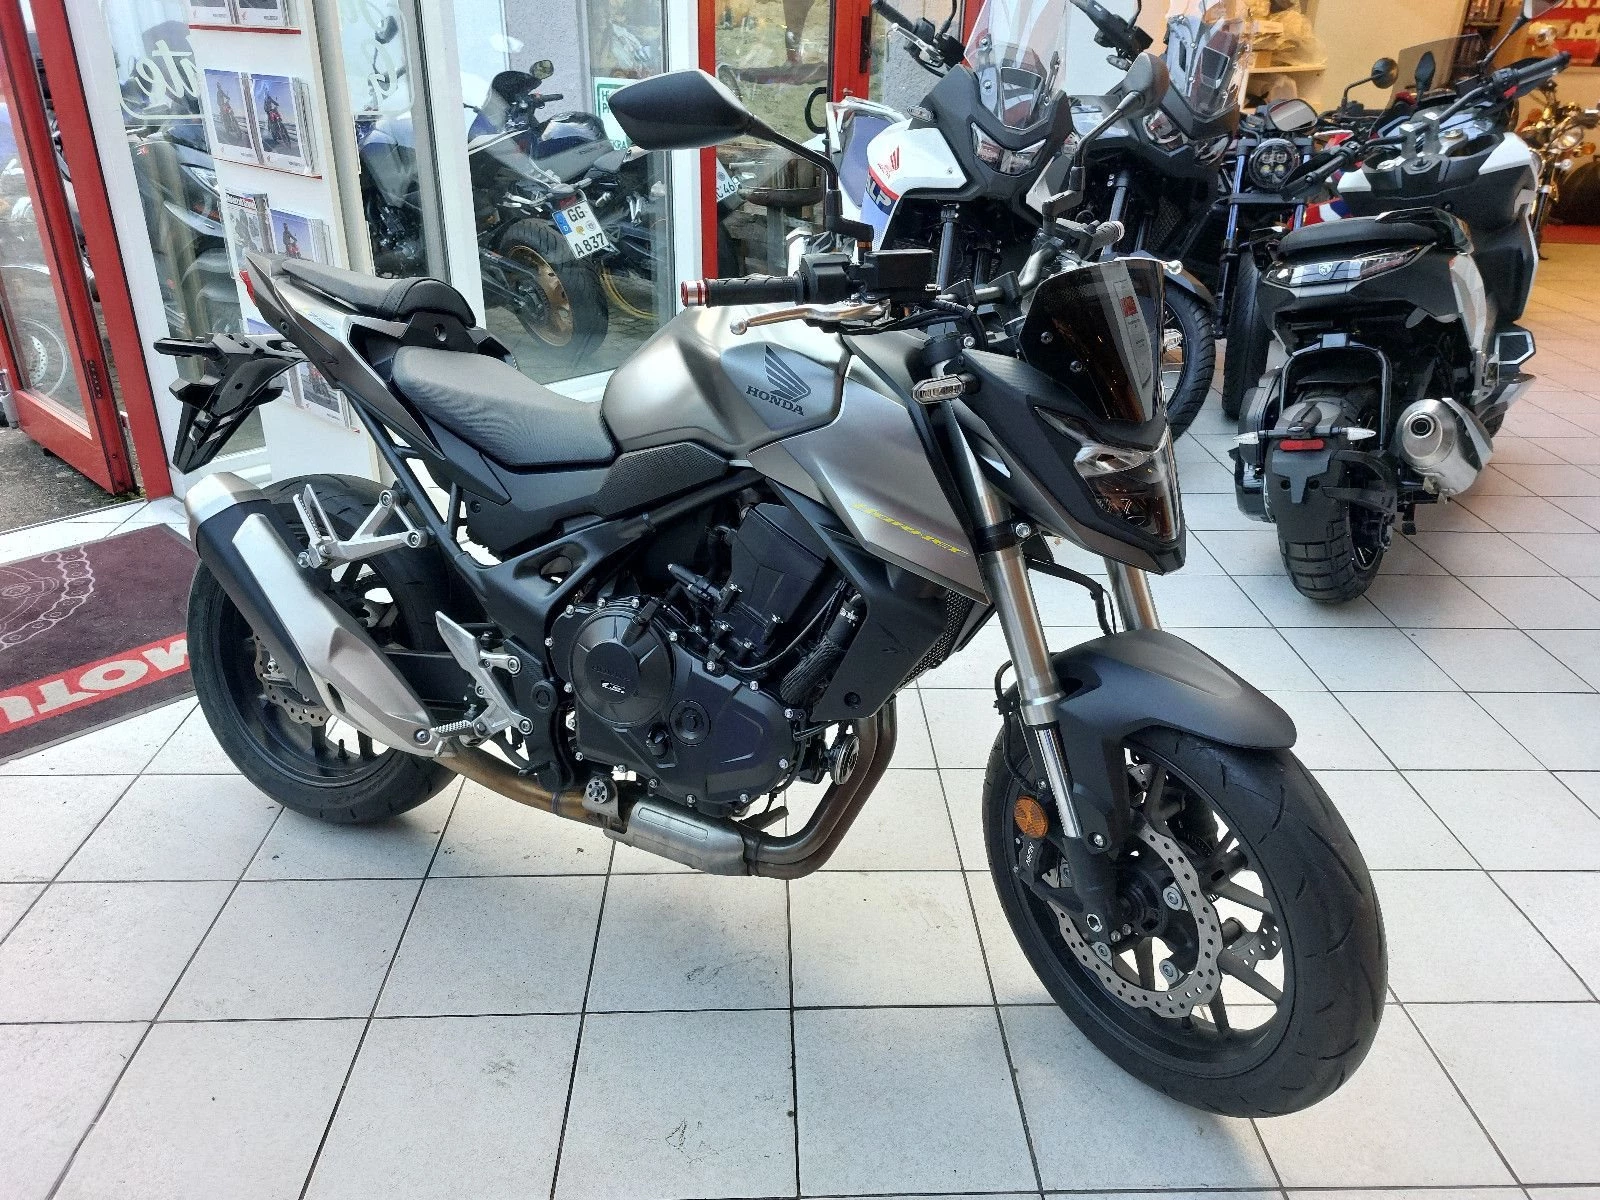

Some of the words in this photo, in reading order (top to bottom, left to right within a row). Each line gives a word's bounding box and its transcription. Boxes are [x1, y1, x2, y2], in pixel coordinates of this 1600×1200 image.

[567, 206, 586, 222] GG
[583, 233, 605, 251] 837
[746, 385, 805, 416] HONDA
